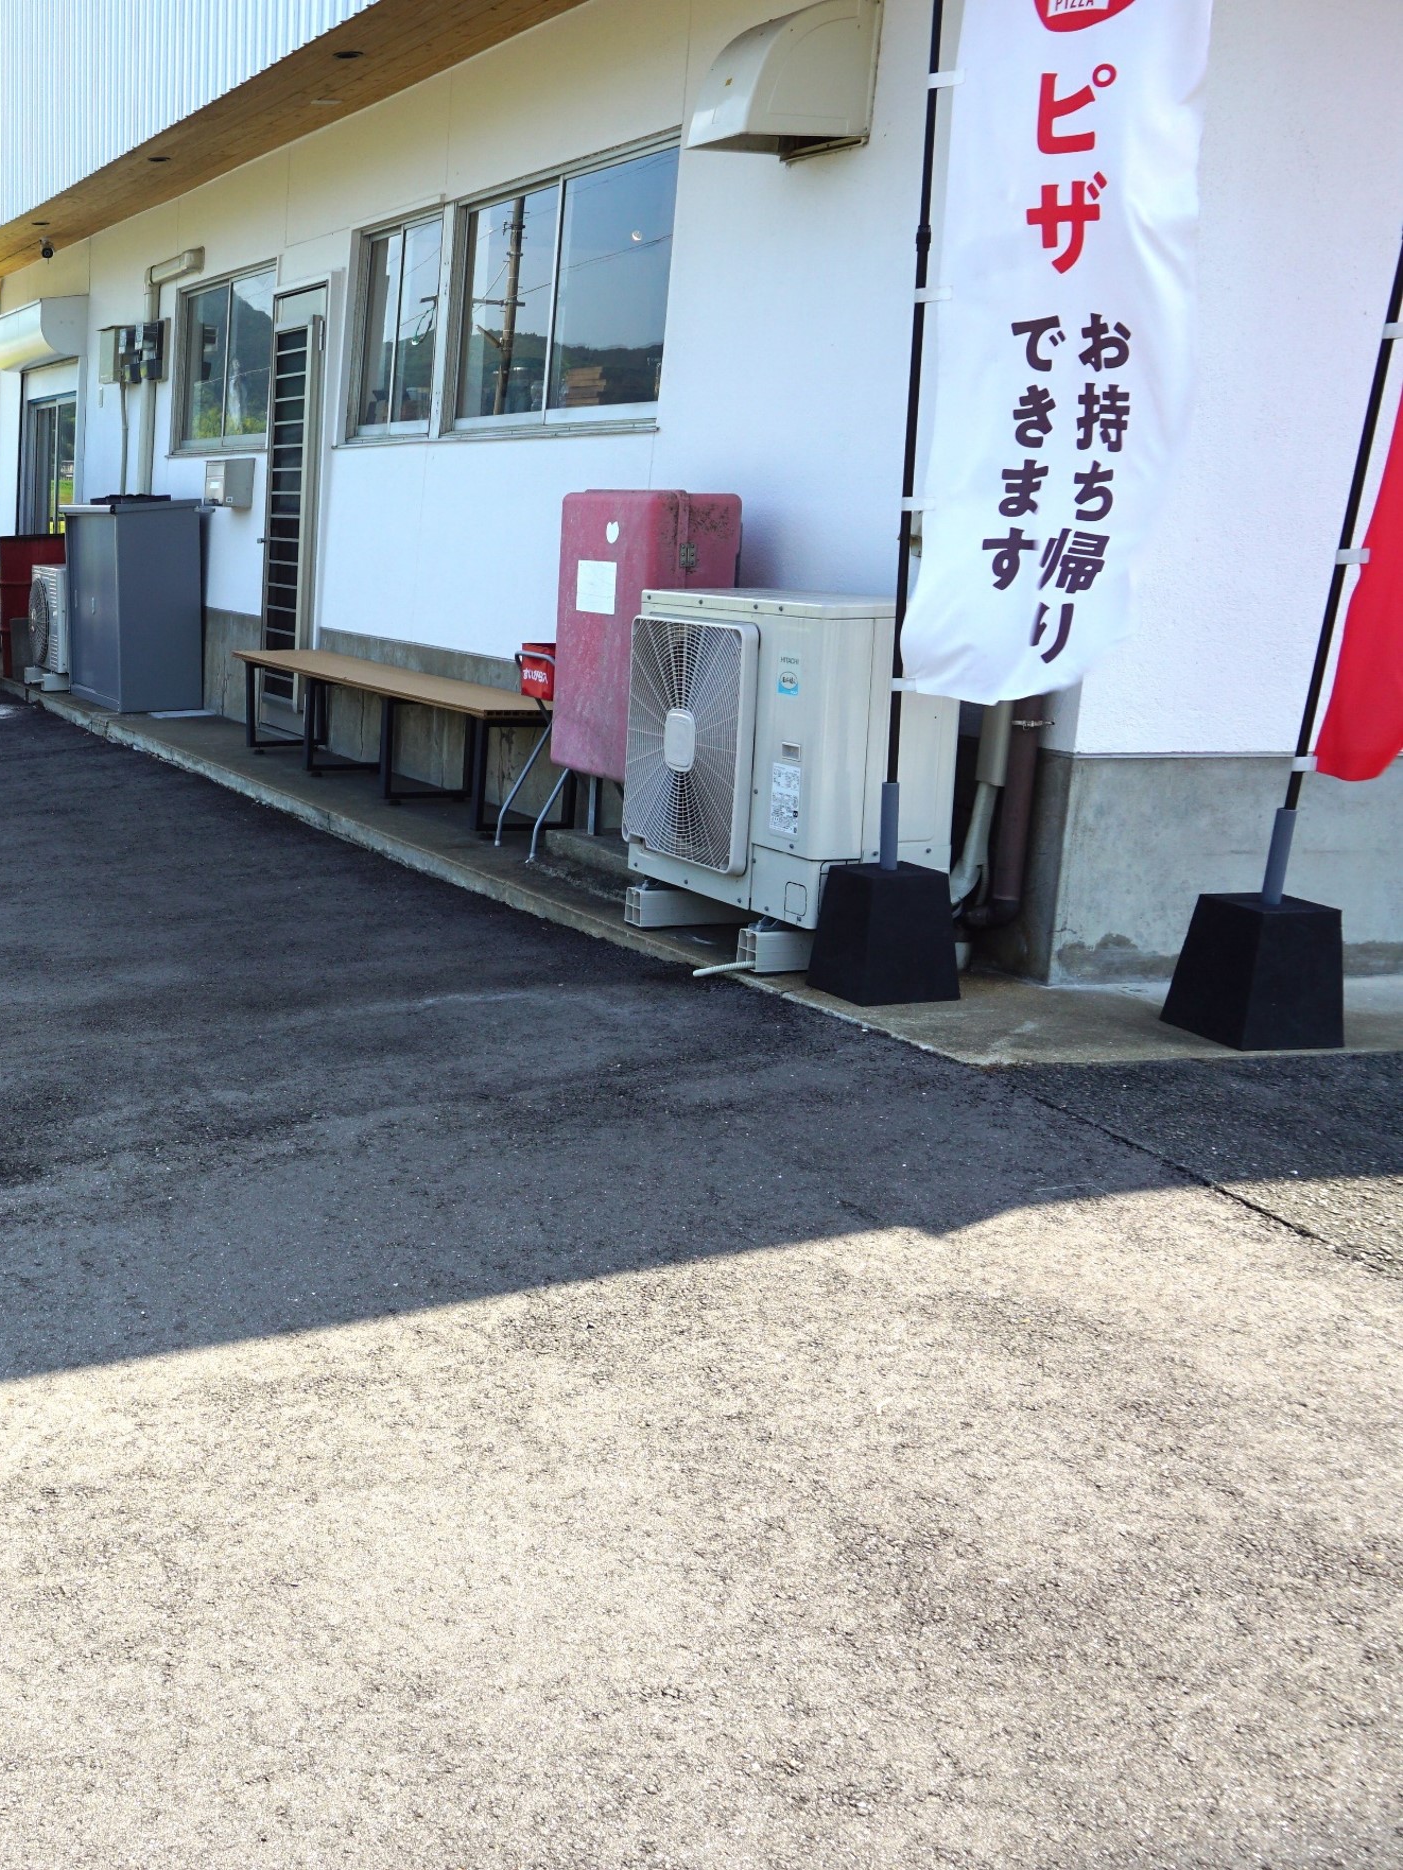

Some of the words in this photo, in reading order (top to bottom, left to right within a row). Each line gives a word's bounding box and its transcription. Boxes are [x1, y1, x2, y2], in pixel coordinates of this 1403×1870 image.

[1026, 63, 1117, 274] ピザ
[982, 315, 1067, 591] できます
[1030, 312, 1132, 664] お持ち帰り
[780, 656, 800, 665] HITACHI
